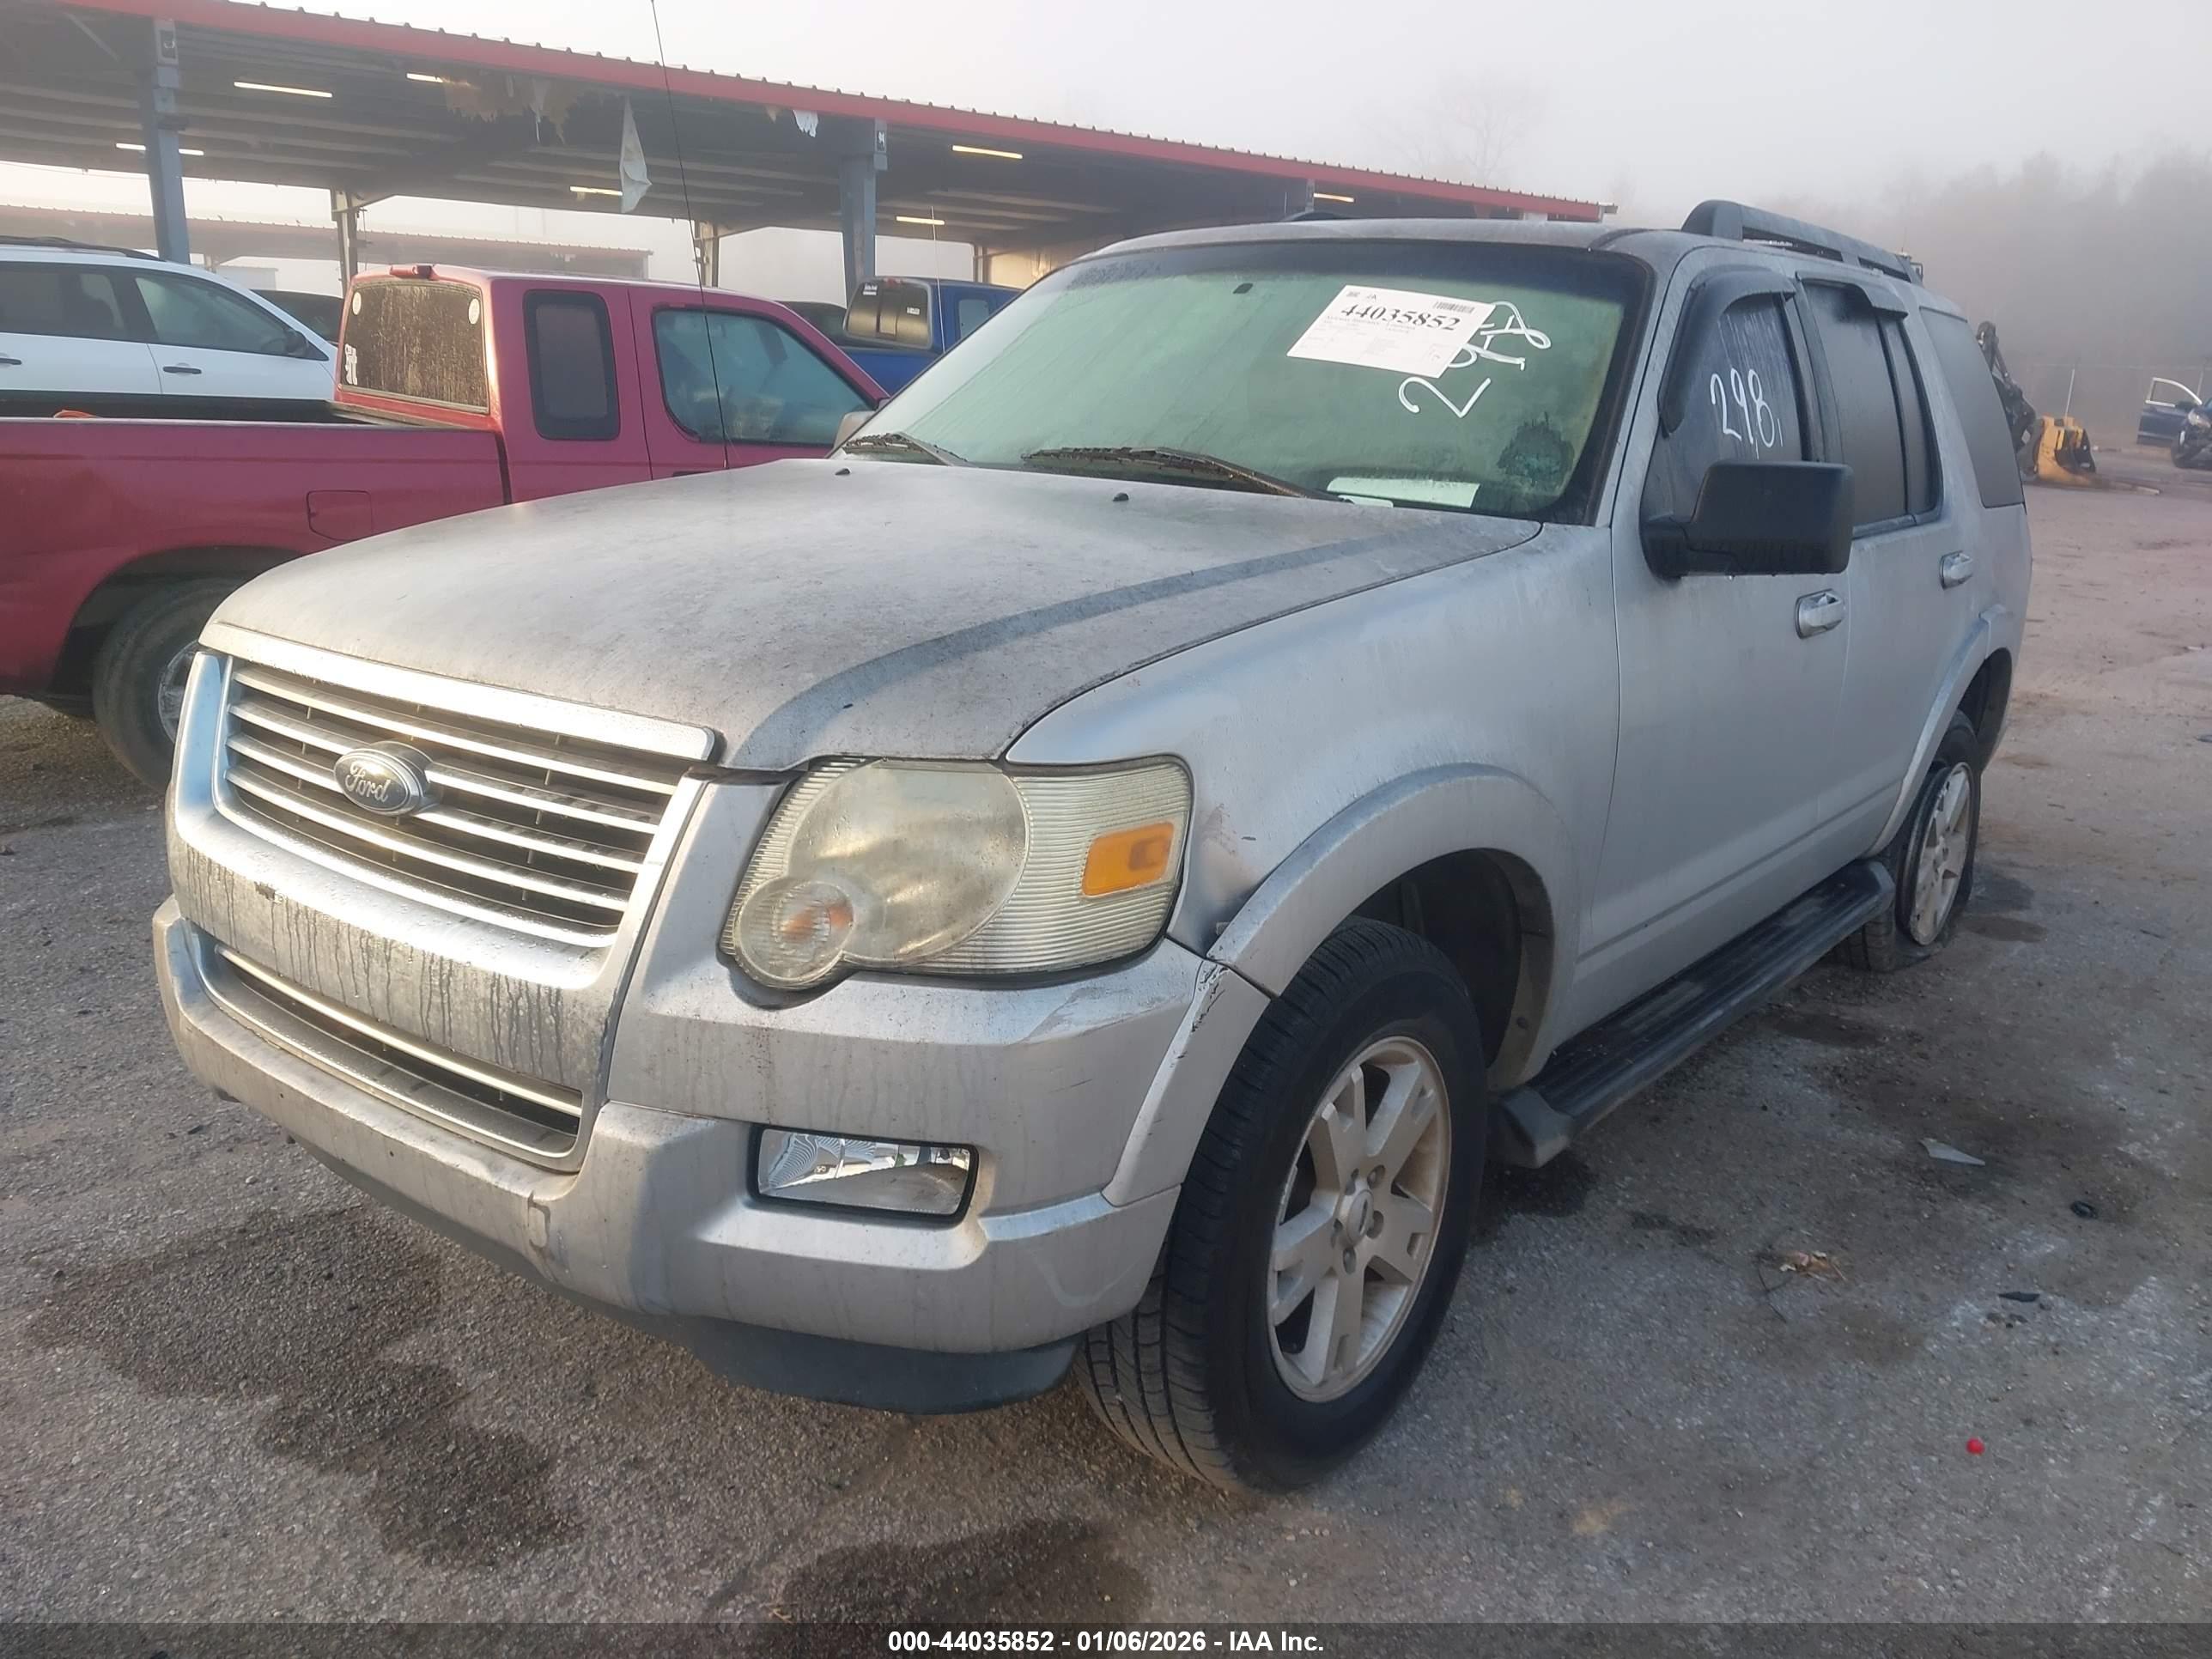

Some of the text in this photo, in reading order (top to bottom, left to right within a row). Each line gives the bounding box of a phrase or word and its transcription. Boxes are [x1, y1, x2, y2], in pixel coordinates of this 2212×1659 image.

[1341, 304, 1461, 331] 44035852
[1710, 368, 1775, 448] 298
[345, 760, 392, 803] Ford
